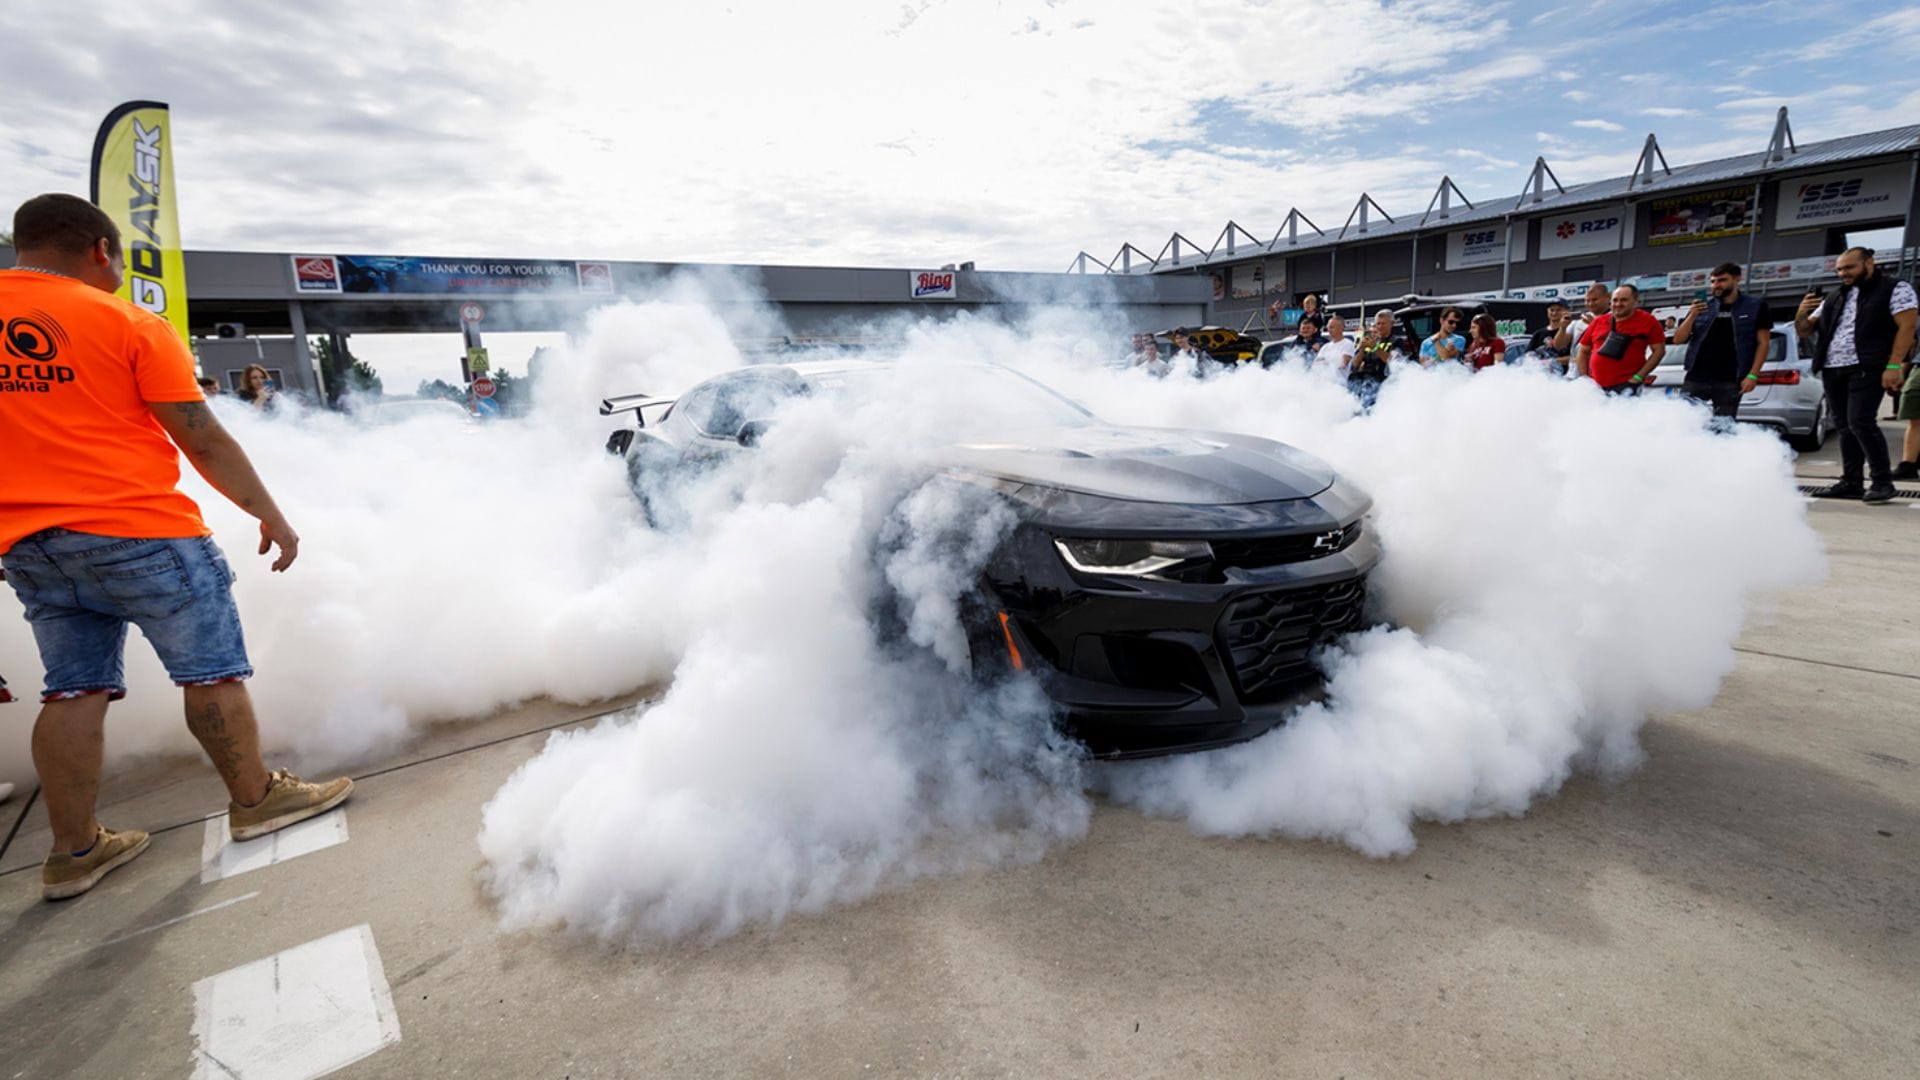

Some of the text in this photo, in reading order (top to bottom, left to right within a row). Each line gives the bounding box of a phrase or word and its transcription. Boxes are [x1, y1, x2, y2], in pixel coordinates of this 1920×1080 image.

[128, 116, 167, 319] GDAY.SK
[1580, 217, 1619, 233] RZP
[420, 263, 570, 275] THANK YOU FOR YOUR VISIT
